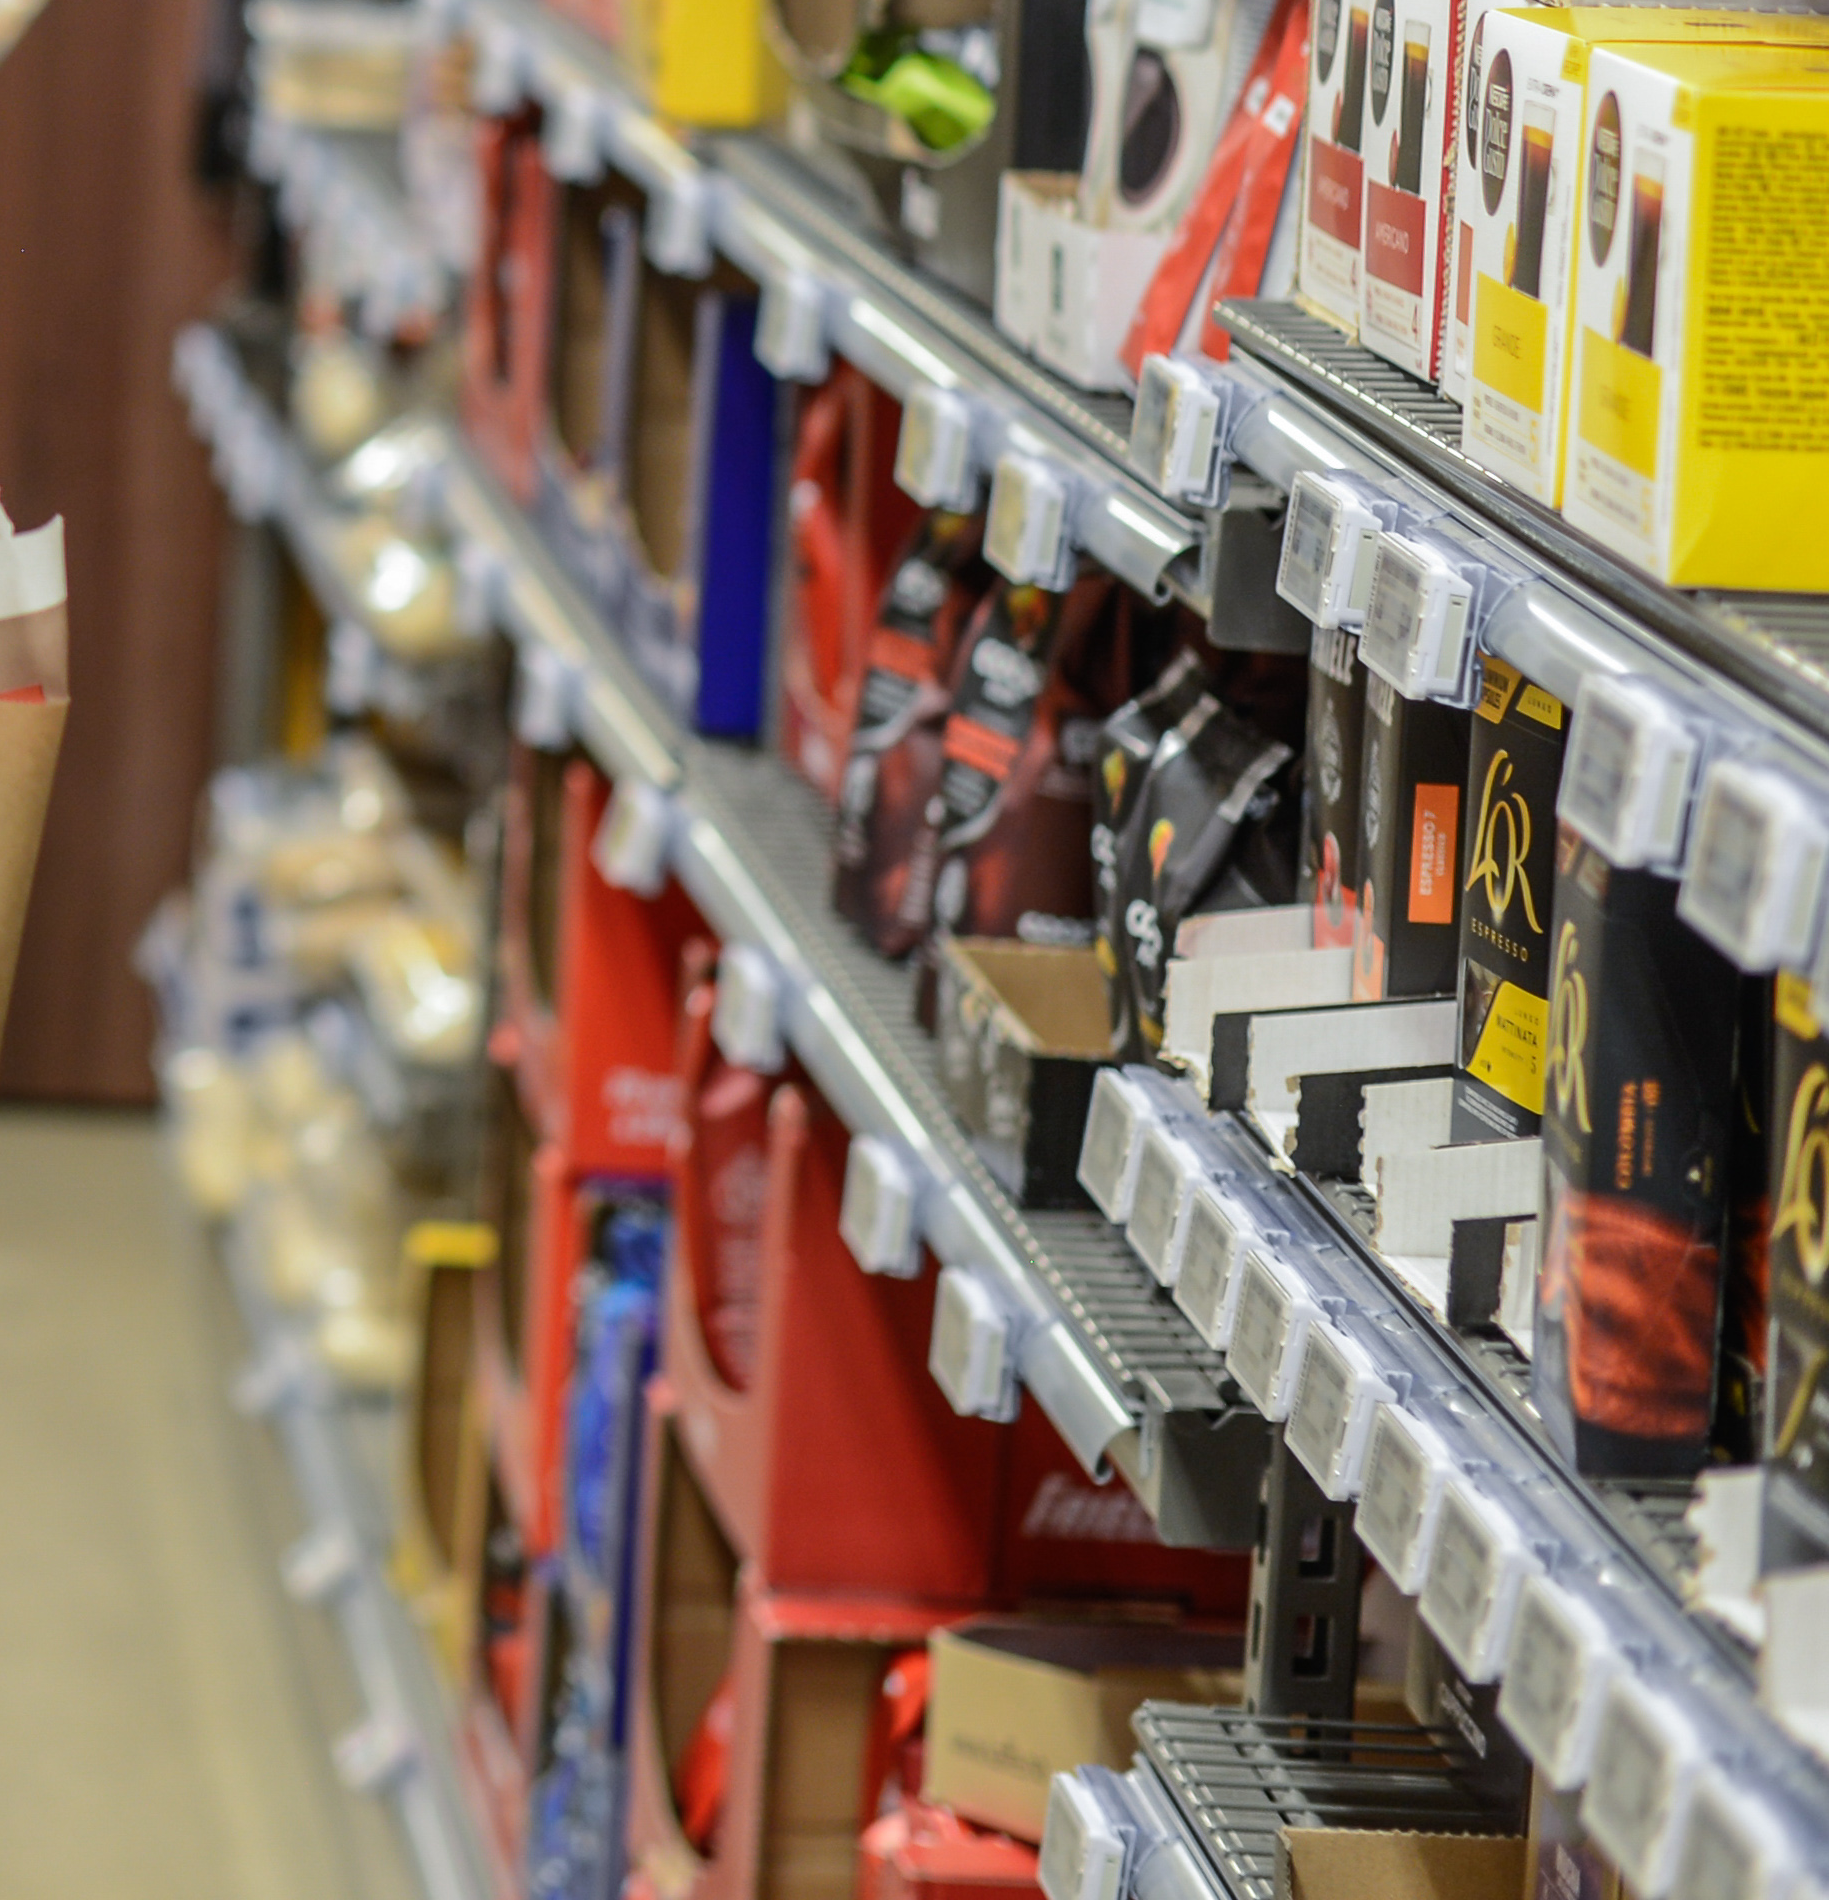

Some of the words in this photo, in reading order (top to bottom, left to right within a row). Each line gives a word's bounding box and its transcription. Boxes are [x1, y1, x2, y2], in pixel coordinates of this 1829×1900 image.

[1419, 822, 1436, 897] ESPRESSO
[1470, 916, 1529, 963] ESPRESSO
[1495, 1012, 1539, 1048] MATTINATA
